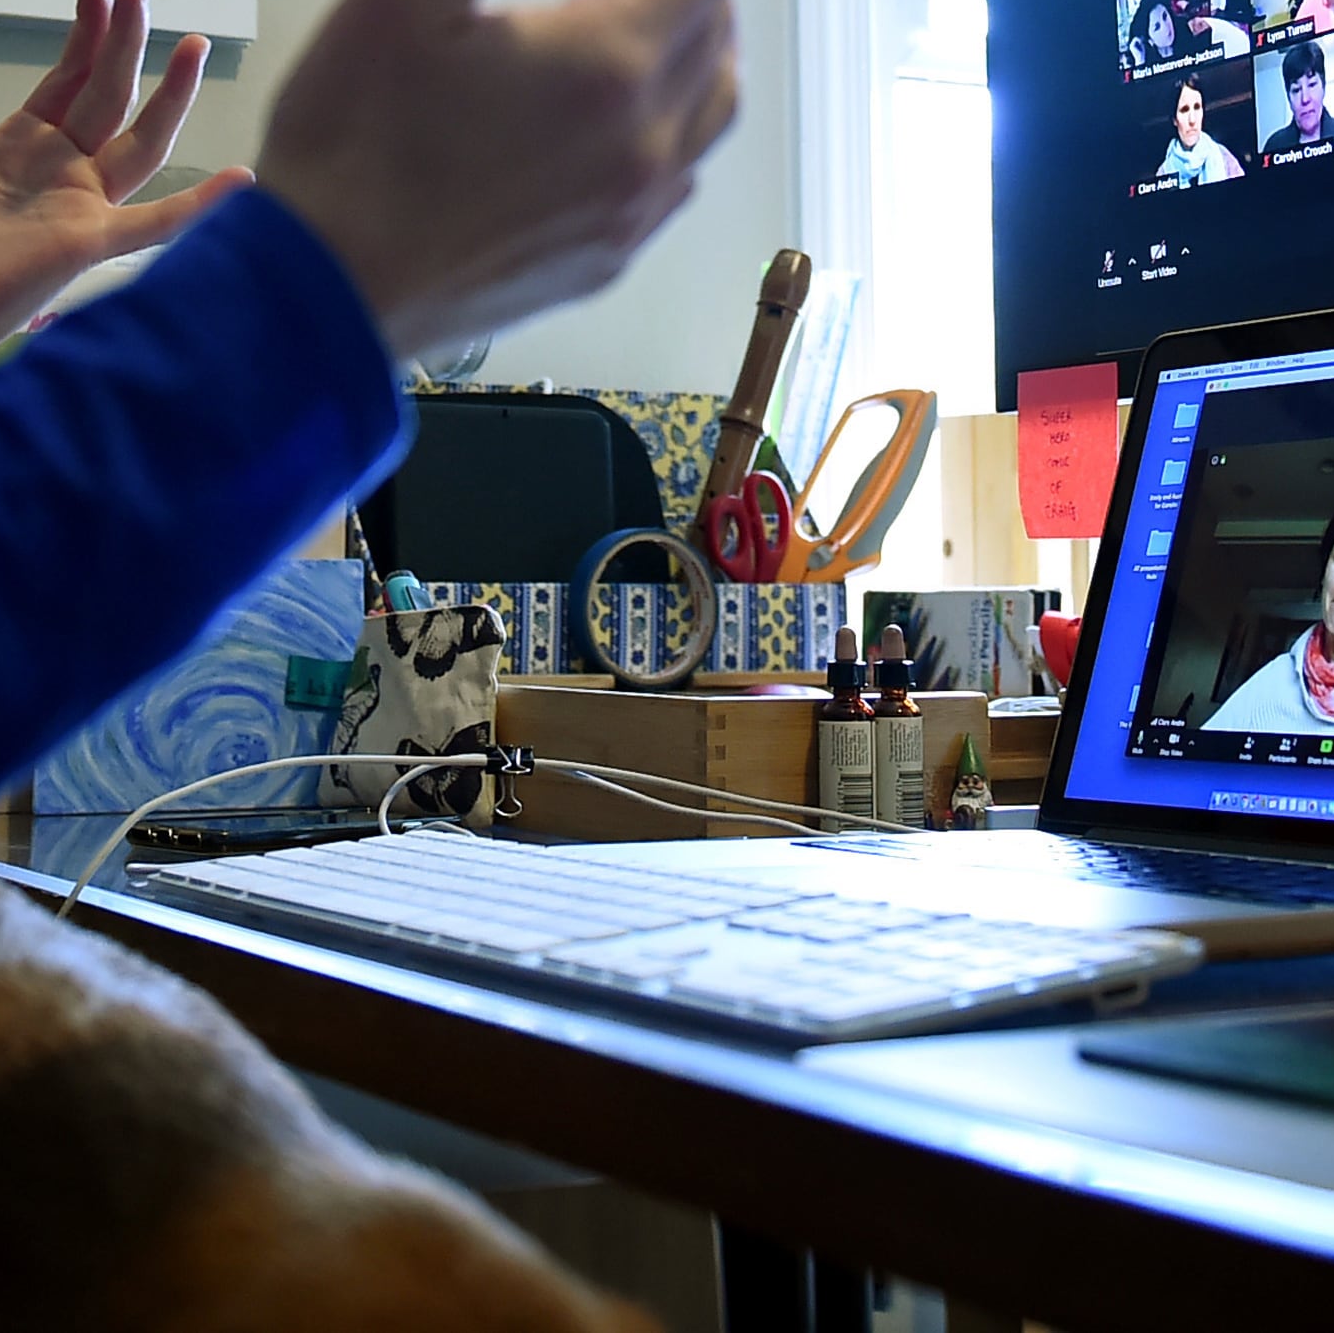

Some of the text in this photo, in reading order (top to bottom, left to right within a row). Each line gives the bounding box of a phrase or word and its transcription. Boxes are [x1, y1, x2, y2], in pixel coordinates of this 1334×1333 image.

[1267, 19, 1313, 45] Lynn Turner
[1273, 141, 1333, 168] Carolyn Crouch
[1138, 176, 1178, 196] Clare Andre
[1097, 275, 1122, 289] Unmute
[1141, 266, 1178, 281] Start Video
[979, 598, 992, 660] Pencils
